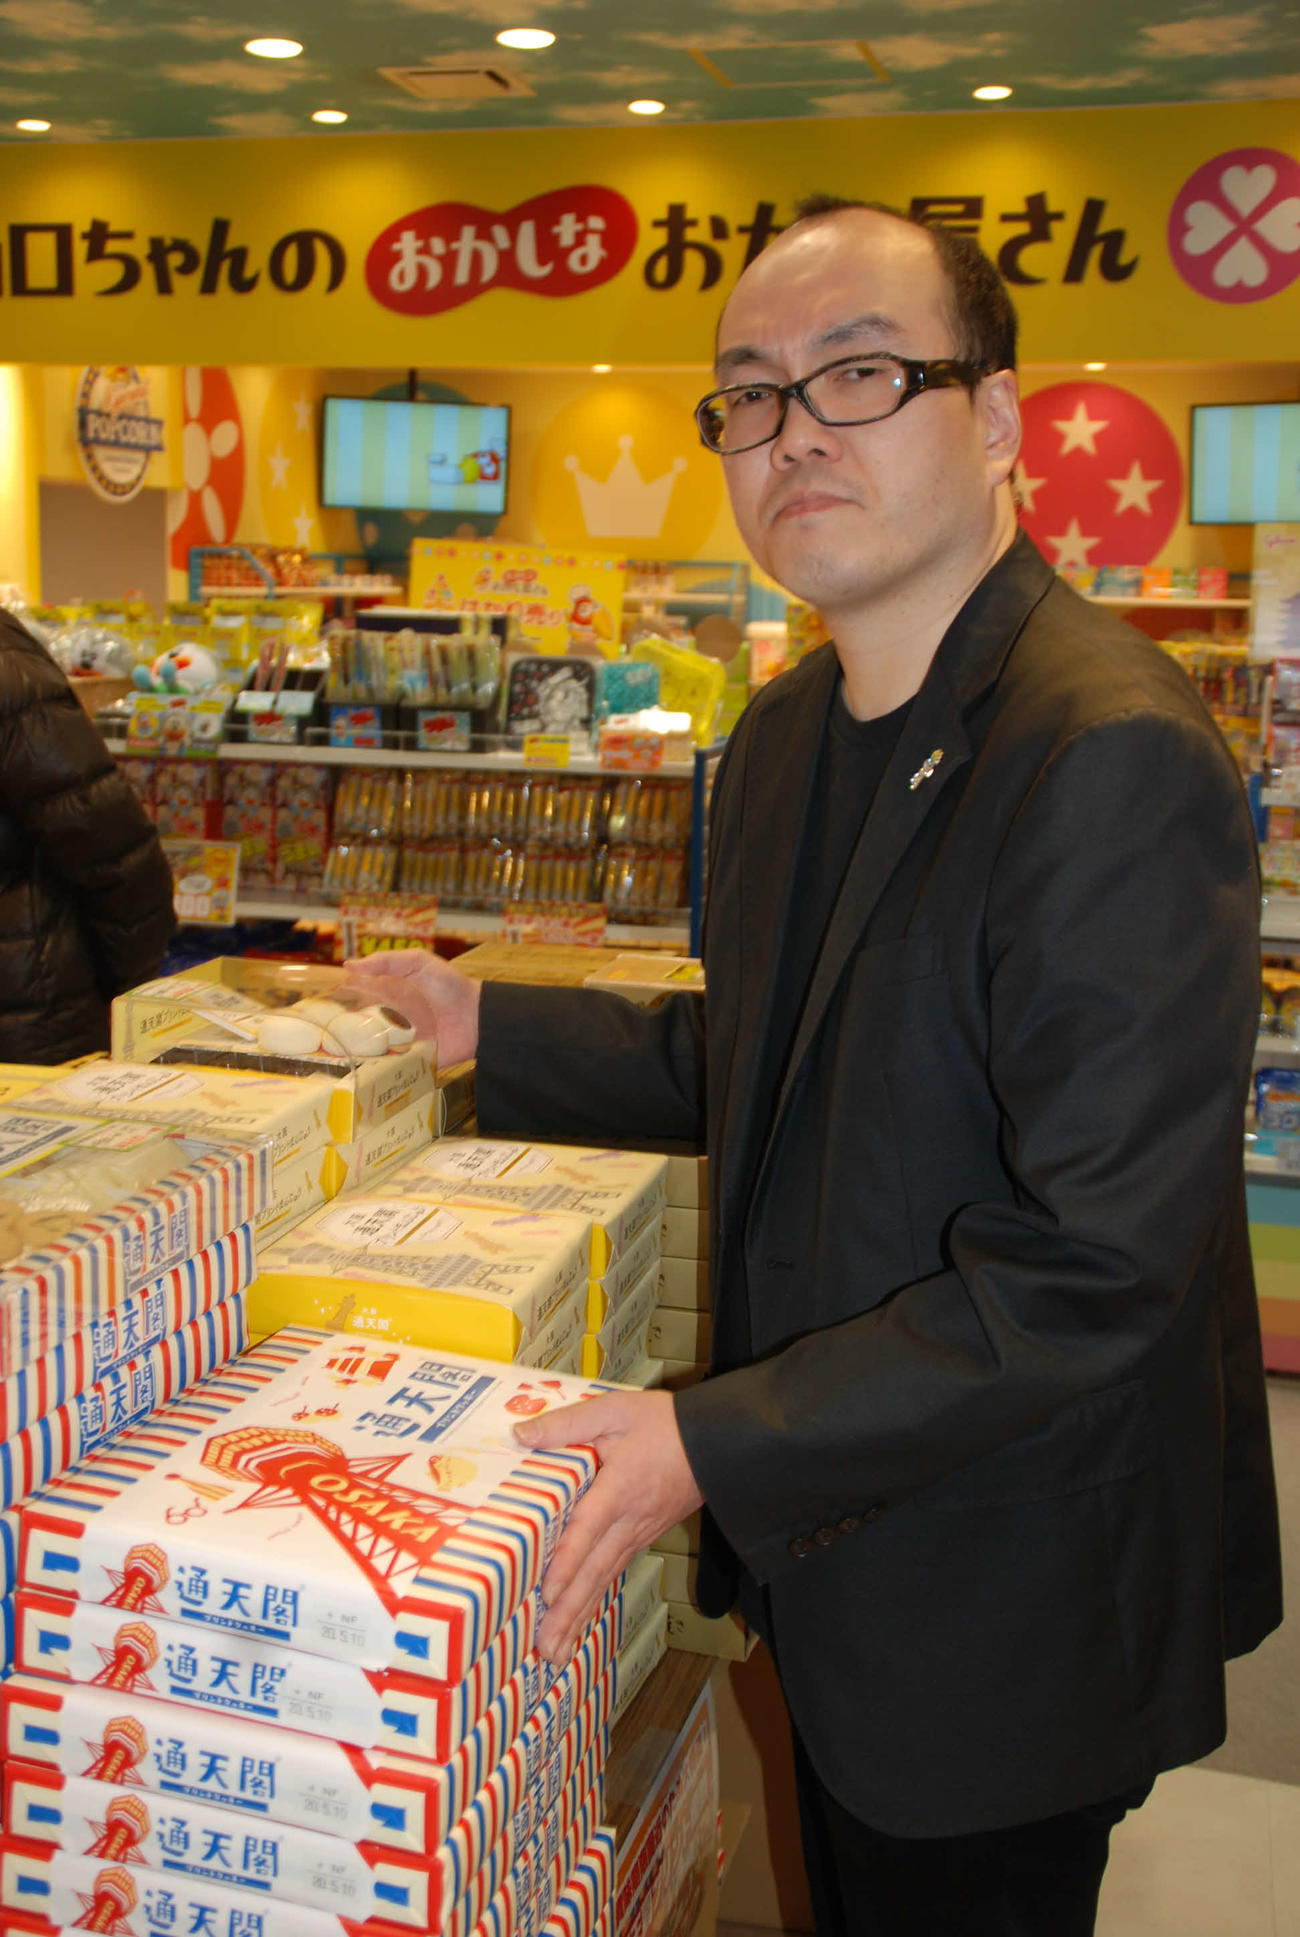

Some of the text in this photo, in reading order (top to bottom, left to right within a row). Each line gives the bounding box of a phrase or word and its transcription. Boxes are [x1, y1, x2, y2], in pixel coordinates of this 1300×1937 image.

[0, 218, 346, 296] ロちゃんの
[388, 213, 607, 292] おかしな
[86, 411, 161, 449] POPCORN
[93, 1286, 166, 1366] 通天閣
[80, 1362, 154, 1440] 通天閣
[353, 1361, 478, 1439] 通天閣
[309, 1473, 440, 1543] OSAKA
[174, 1565, 299, 1628] 通天閣
[164, 1643, 287, 1703] 通天閣
[153, 1737, 276, 1799] 通天閣
[156, 1816, 279, 1879] 通天閣
[143, 1888, 265, 1937] 通天閣
